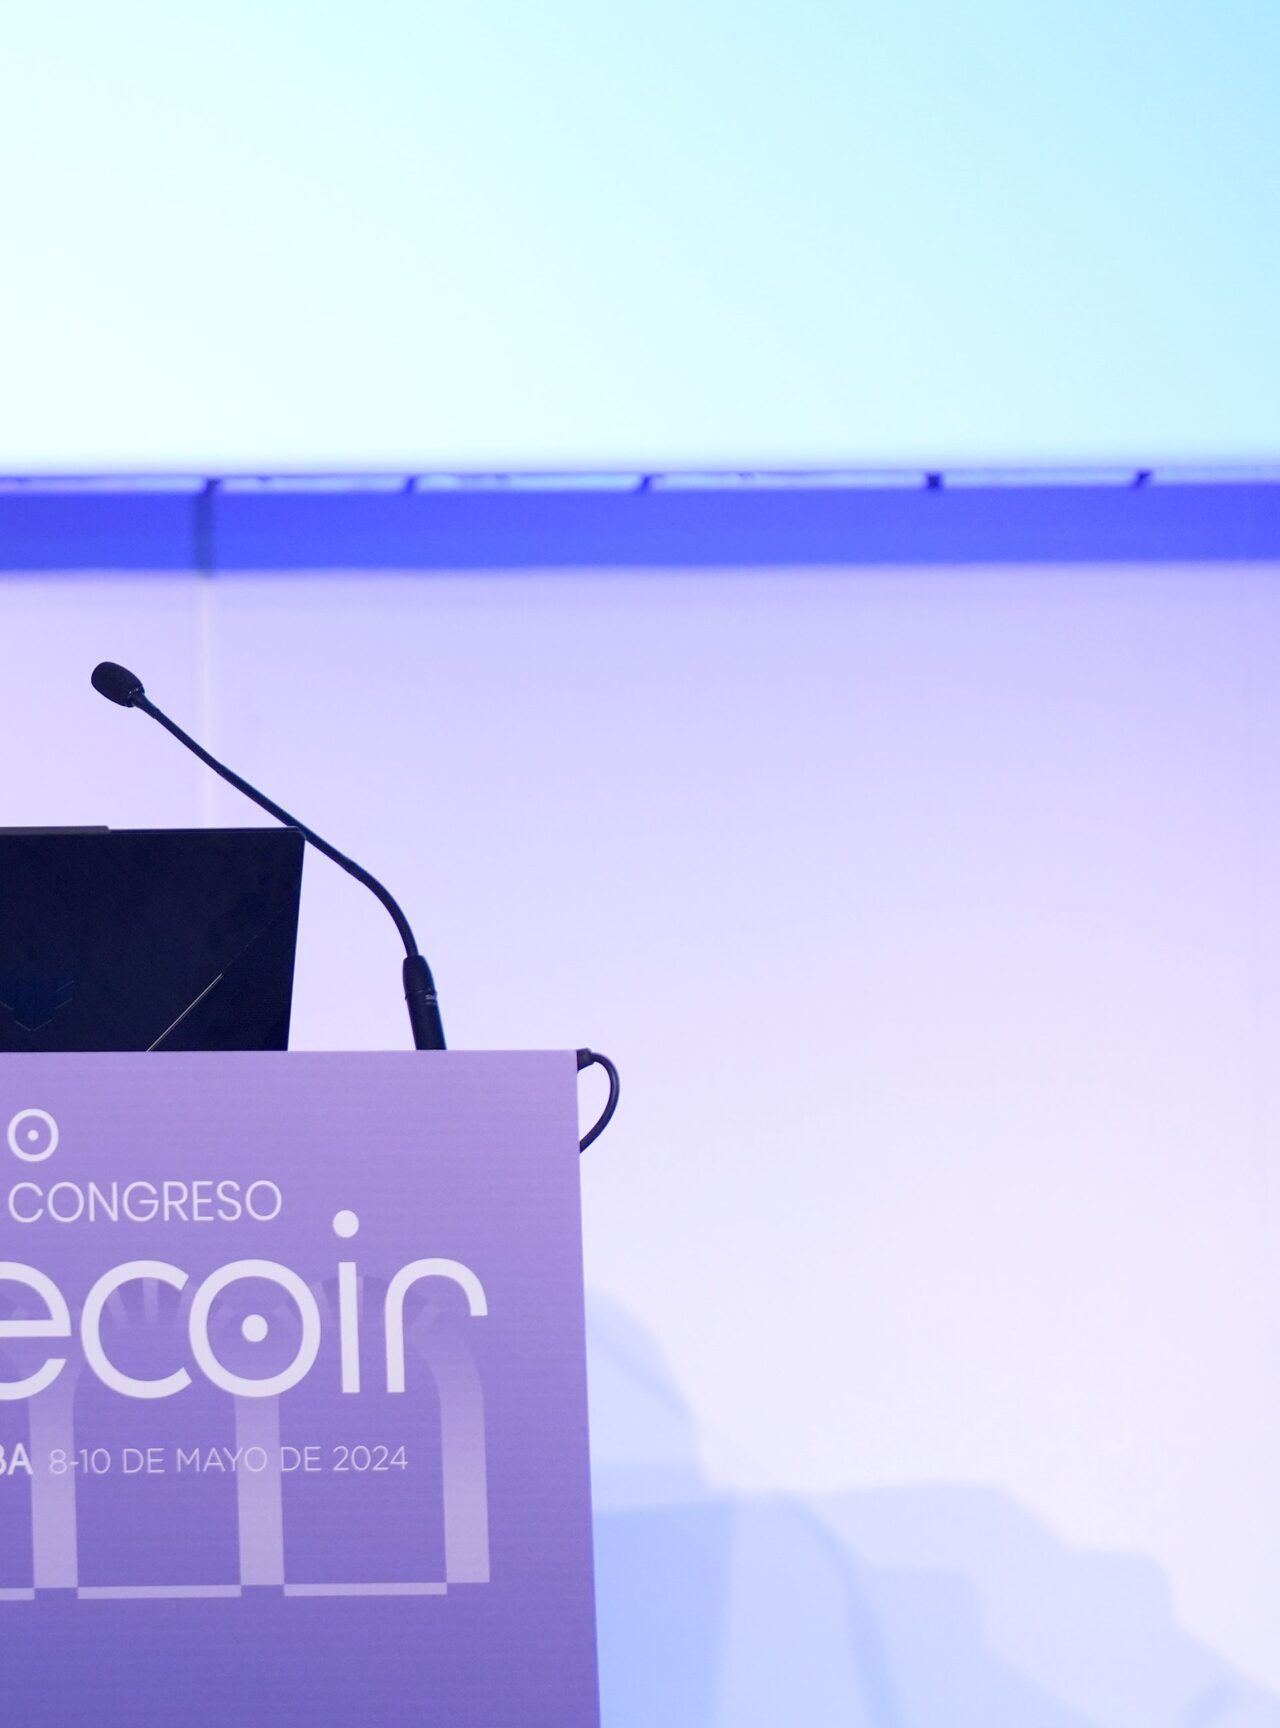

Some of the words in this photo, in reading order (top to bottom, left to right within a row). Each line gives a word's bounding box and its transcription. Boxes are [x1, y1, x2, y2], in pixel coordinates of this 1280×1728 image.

[7, 1179, 283, 1224] CONGRESO
[48, 1447, 112, 1475] 8-10
[122, 1447, 165, 1474] DE
[175, 1445, 269, 1473] MAYO
[279, 1445, 322, 1472] DE
[332, 1444, 409, 1472] 2024
